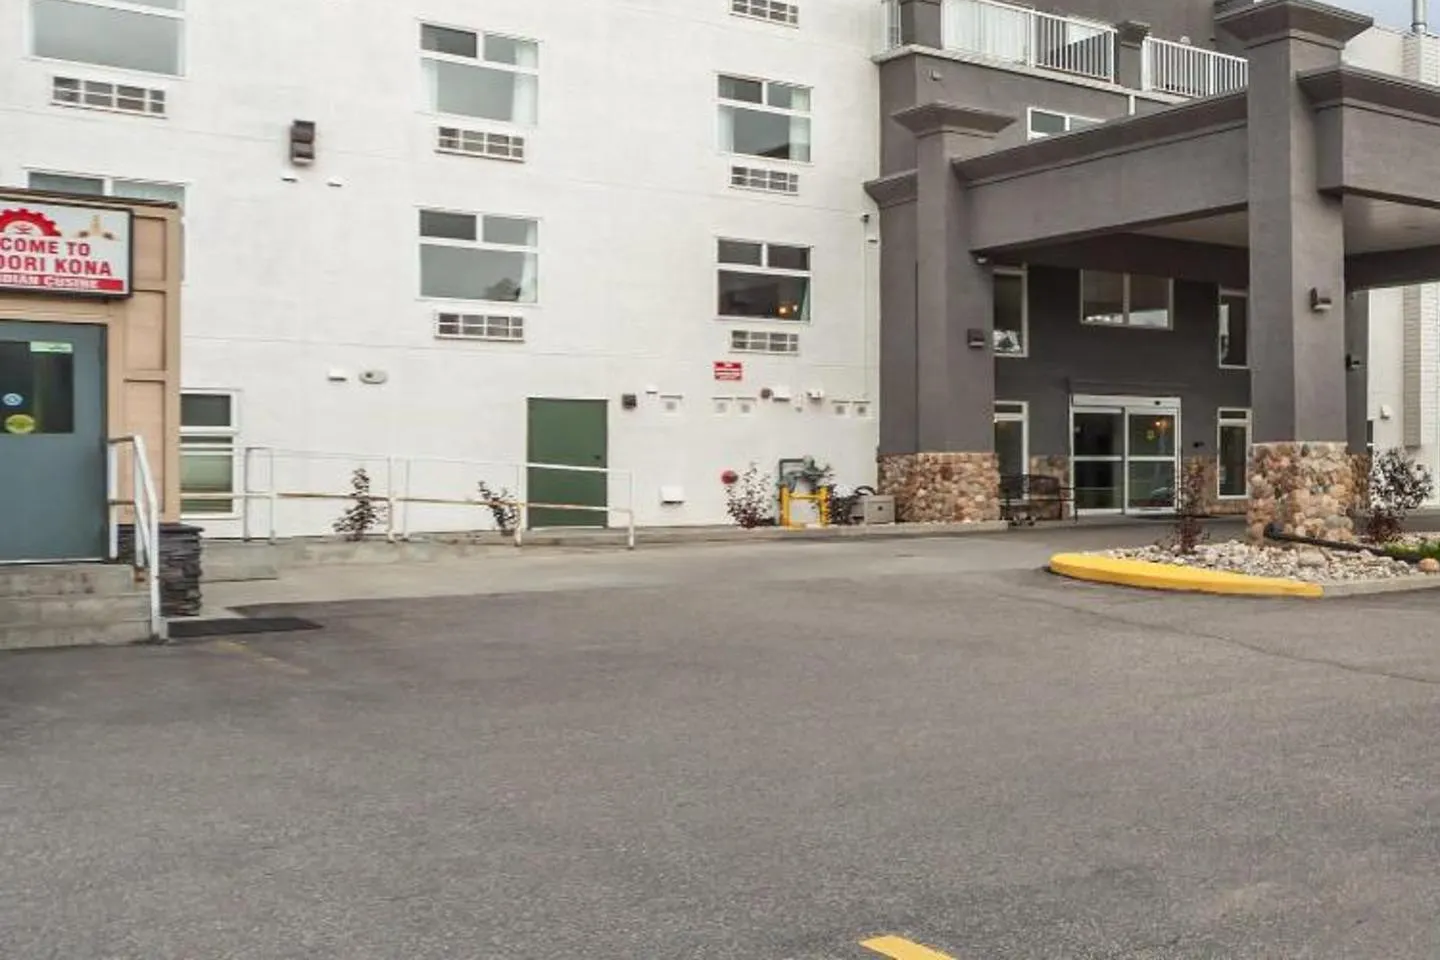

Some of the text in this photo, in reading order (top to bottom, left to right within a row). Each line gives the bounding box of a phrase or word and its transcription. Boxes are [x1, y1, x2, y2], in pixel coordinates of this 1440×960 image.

[0, 237, 91, 256] COME TO
[55, 258, 112, 276] KONA
